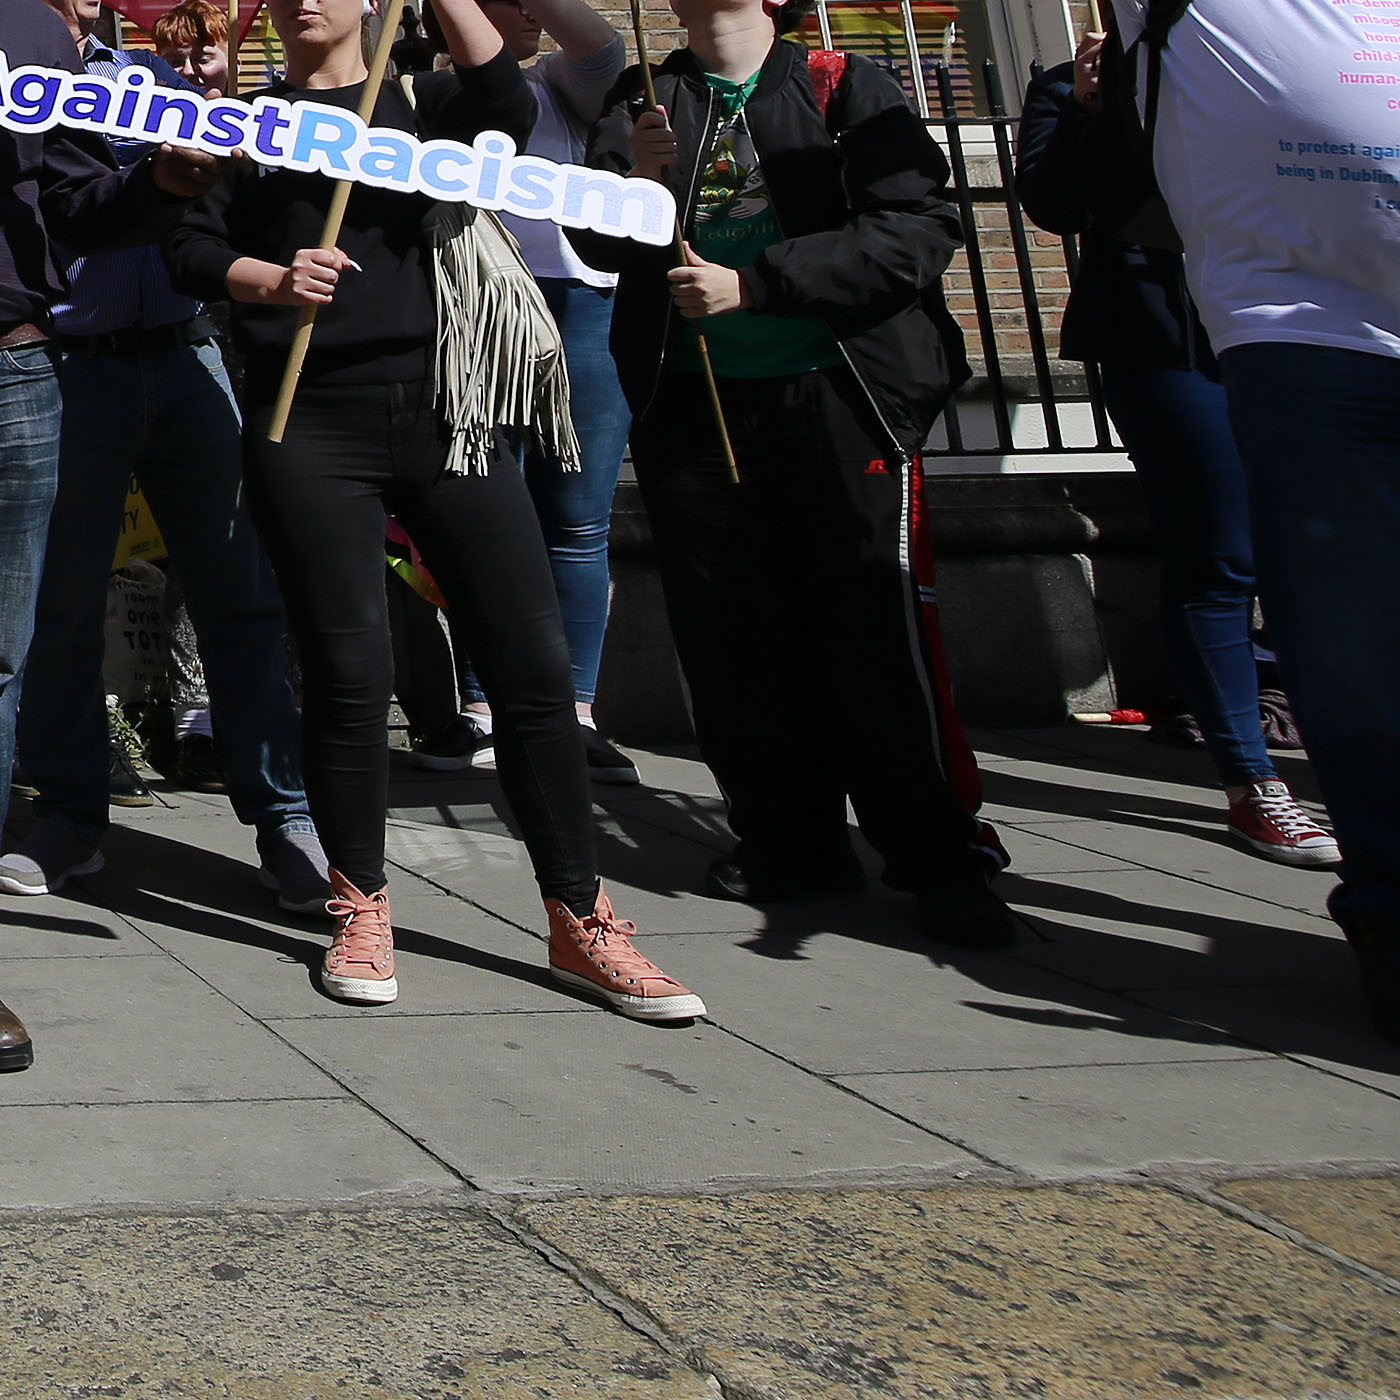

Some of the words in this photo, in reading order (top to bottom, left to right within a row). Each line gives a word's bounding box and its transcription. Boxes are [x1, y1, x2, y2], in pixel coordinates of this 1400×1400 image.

[1279, 139, 1293, 152] to
[1297, 141, 1356, 156] protest
[1276, 163, 1315, 181] being
[1320, 166, 1333, 180] in
[127, 609, 160, 625] one
